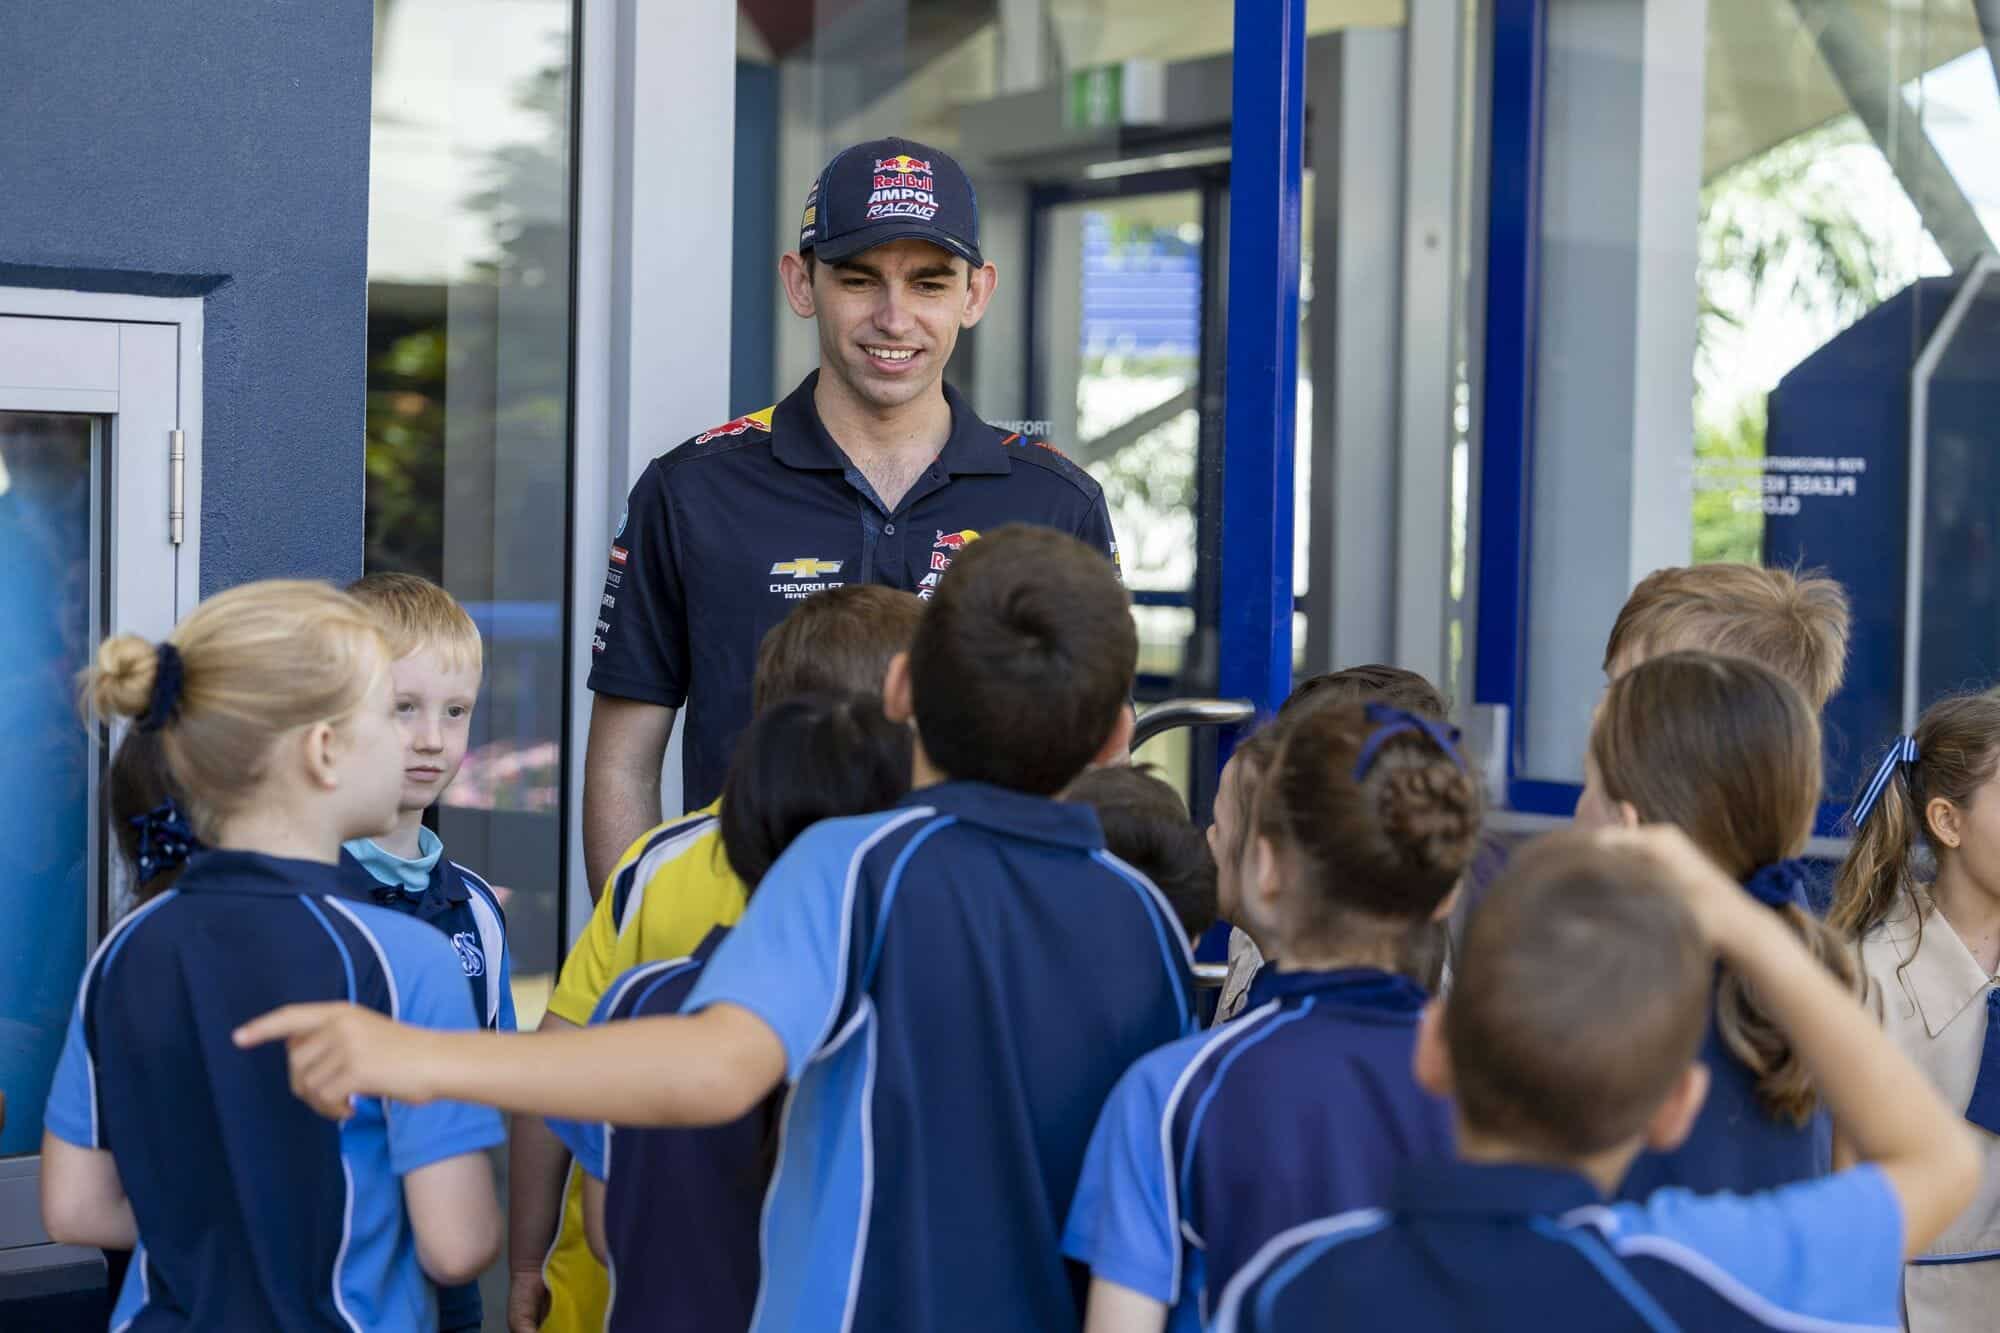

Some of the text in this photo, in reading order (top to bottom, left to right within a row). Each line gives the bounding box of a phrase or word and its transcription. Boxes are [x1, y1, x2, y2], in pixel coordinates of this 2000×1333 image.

[874, 172, 933, 192] Red Bull
[867, 189, 939, 207] AMPOL
[866, 202, 936, 218] RACING
[930, 551, 952, 571] Re
